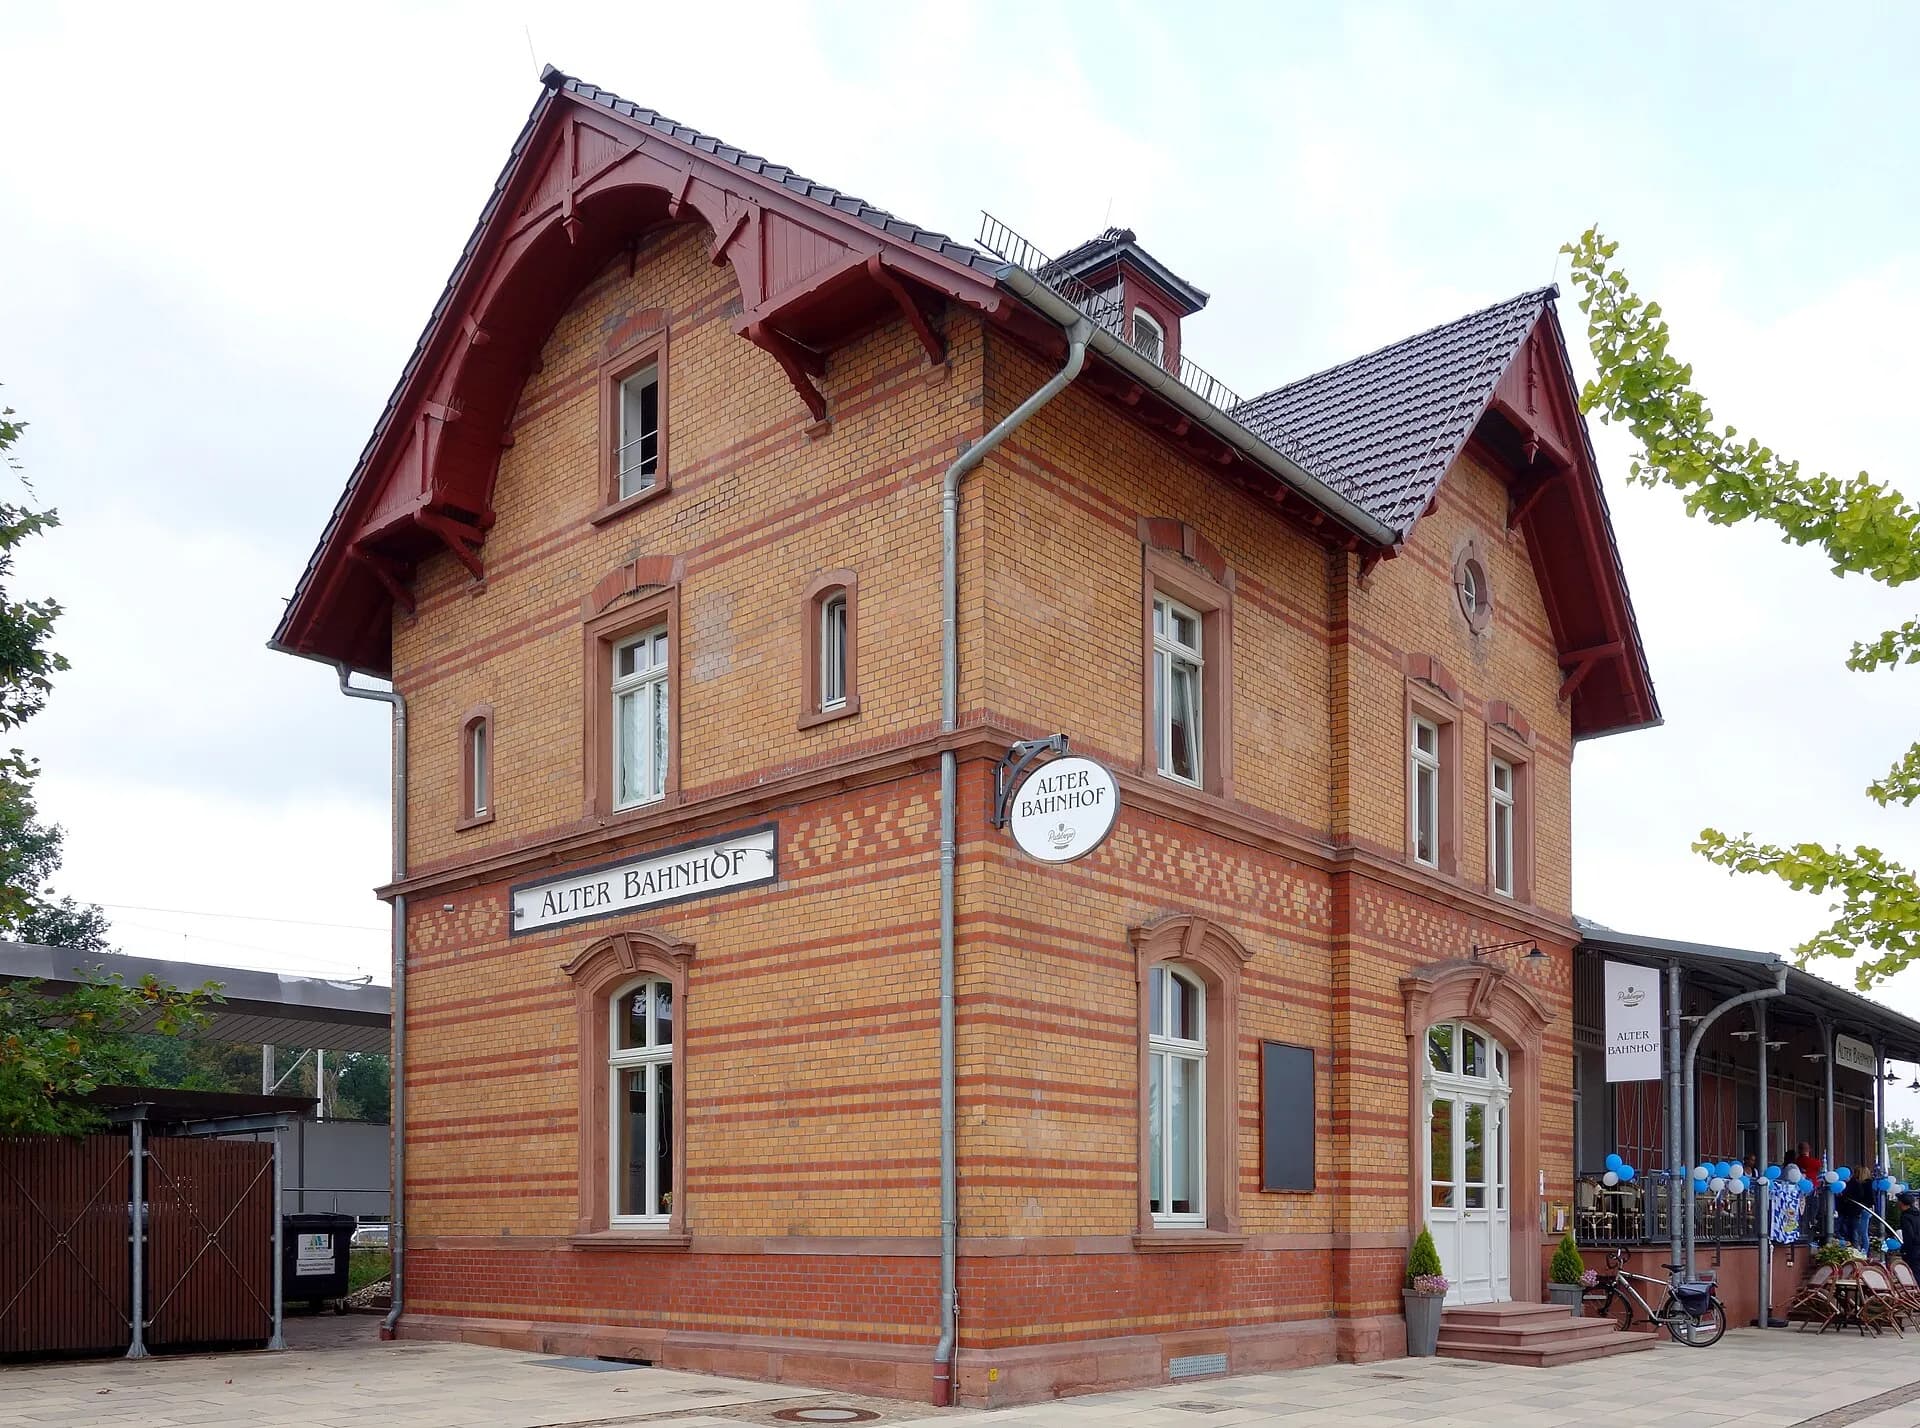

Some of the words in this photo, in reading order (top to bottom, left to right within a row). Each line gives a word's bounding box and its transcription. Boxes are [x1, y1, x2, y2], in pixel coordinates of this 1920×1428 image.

[1036, 770, 1090, 796] ALTER
[1022, 788, 1106, 818] BAHNHOF
[540, 881, 612, 918] ALTER
[623, 849, 747, 900] BAHNHOF
[1616, 1030, 1650, 1041] ALTER
[1607, 1043, 1660, 1055] BAHNHOF
